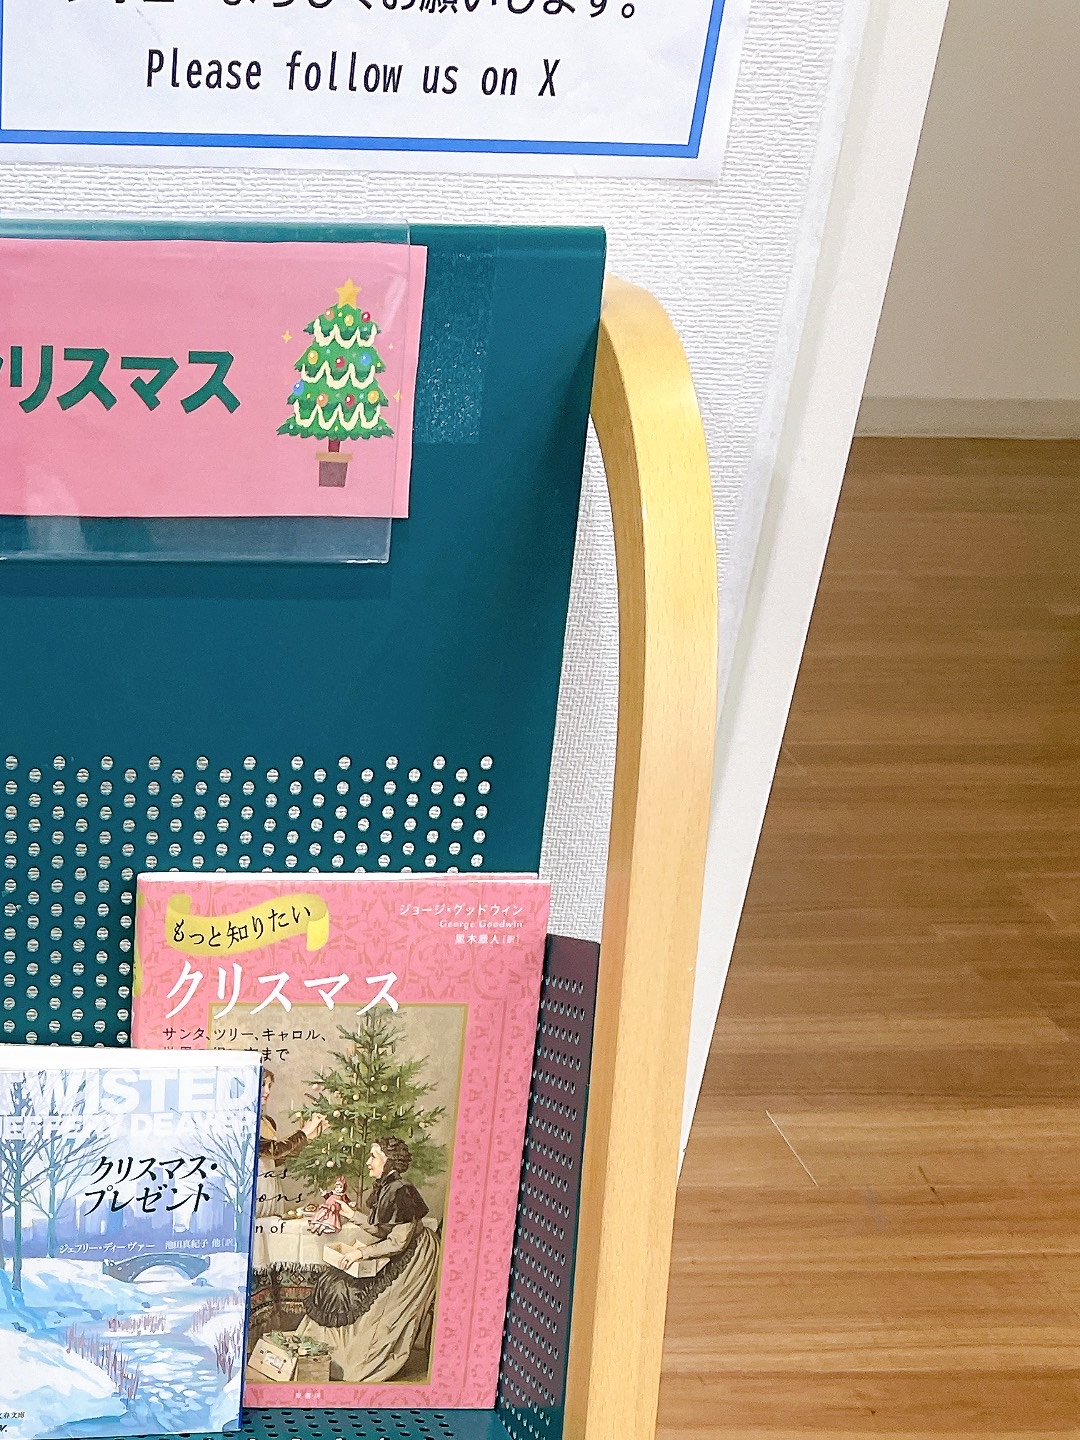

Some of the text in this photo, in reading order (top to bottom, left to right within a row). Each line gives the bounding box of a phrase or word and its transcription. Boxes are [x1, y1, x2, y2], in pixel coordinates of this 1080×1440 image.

[146, 47, 561, 96] Please follow us on X
[399, 903, 524, 917] ジョージ・グッドウィン
[173, 903, 312, 949] もっと知りたい
[439, 919, 524, 931] George Goodwin
[165, 960, 401, 1020] クリスマス
[162, 1027, 327, 1041] サンタ、ツリー、キャロル、
[83, 1183, 212, 1217] プレゼント
[59, 1242, 156, 1254] ジェフリー・ディーヴァー
